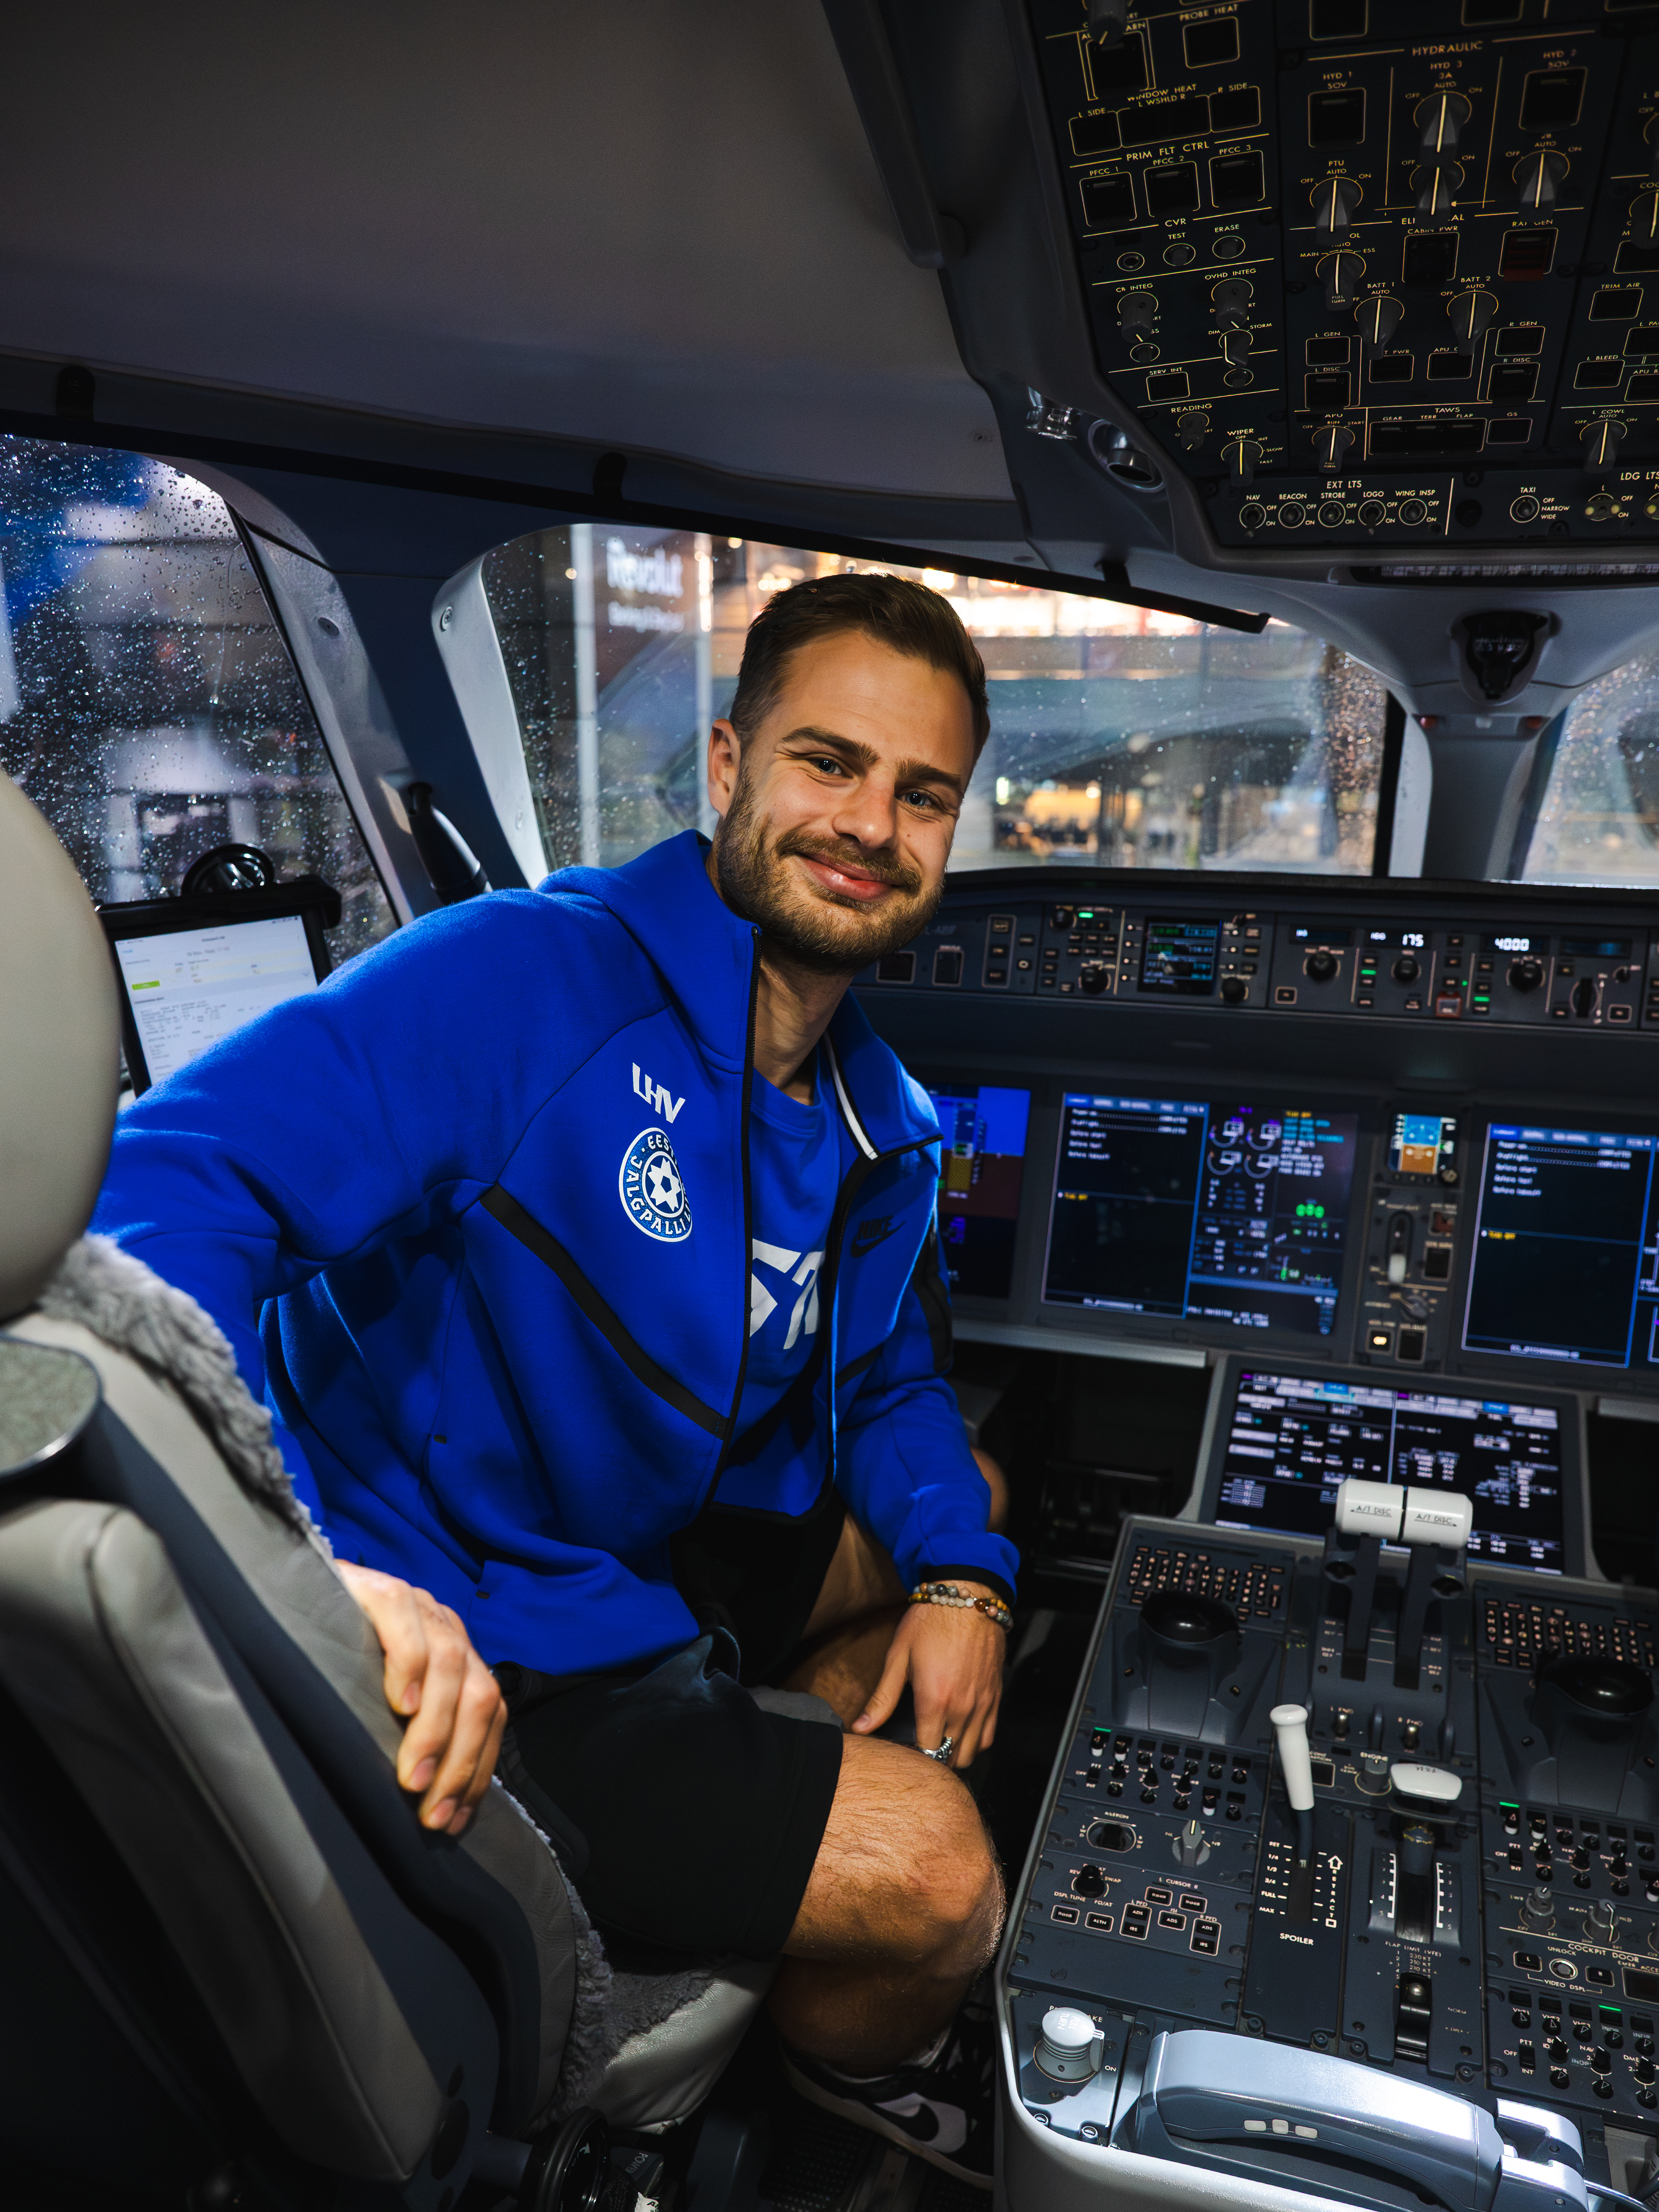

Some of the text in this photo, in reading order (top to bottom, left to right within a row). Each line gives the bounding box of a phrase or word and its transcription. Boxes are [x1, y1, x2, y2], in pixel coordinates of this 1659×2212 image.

[1179, 4, 1239, 22] PROBE HEAT
[1412, 41, 1483, 57] HYDRAULIC
[1430, 61, 1450, 70] HYD
[1323, 72, 1343, 80] HYD
[1175, 84, 1197, 93] HEAT
[1229, 83, 1247, 91] SIDE
[1434, 81, 1457, 89] AUTO
[1146, 95, 1177, 105] WSHLD
[1087, 108, 1106, 116] SIDE
[1126, 141, 1209, 161] PRIM FLT CTRL
[1219, 146, 1241, 155] PFCC
[1153, 157, 1174, 165] PFCC
[1089, 168, 1110, 176] PFCC
[1165, 218, 1186, 228] CVR
[1214, 224, 1240, 233] ERASE
[1205, 268, 1257, 280] OVHD INTEG
[1171, 404, 1212, 413] READING
[1620, 471, 1640, 481] LDG
[1326, 480, 1362, 489] EXT LTS
[1402, 933, 1424, 947] 175
[1495, 938, 1530, 952] 4000
[626, 1156, 686, 1235] JALGPALLI
[856, 1215, 893, 1239] NIKE
[1166, 1878, 1191, 1888] CURSOR
[1280, 1933, 1314, 1945] SPOILER
[1547, 1946, 1576, 1956] UNLOCK
[1568, 1943, 1639, 1963] COCKPIT DOOR
[1544, 1979, 1566, 1988] VIDEO
[1057, 2013, 1070, 2030] TURN
[1068, 2016, 1080, 2029] PULL
